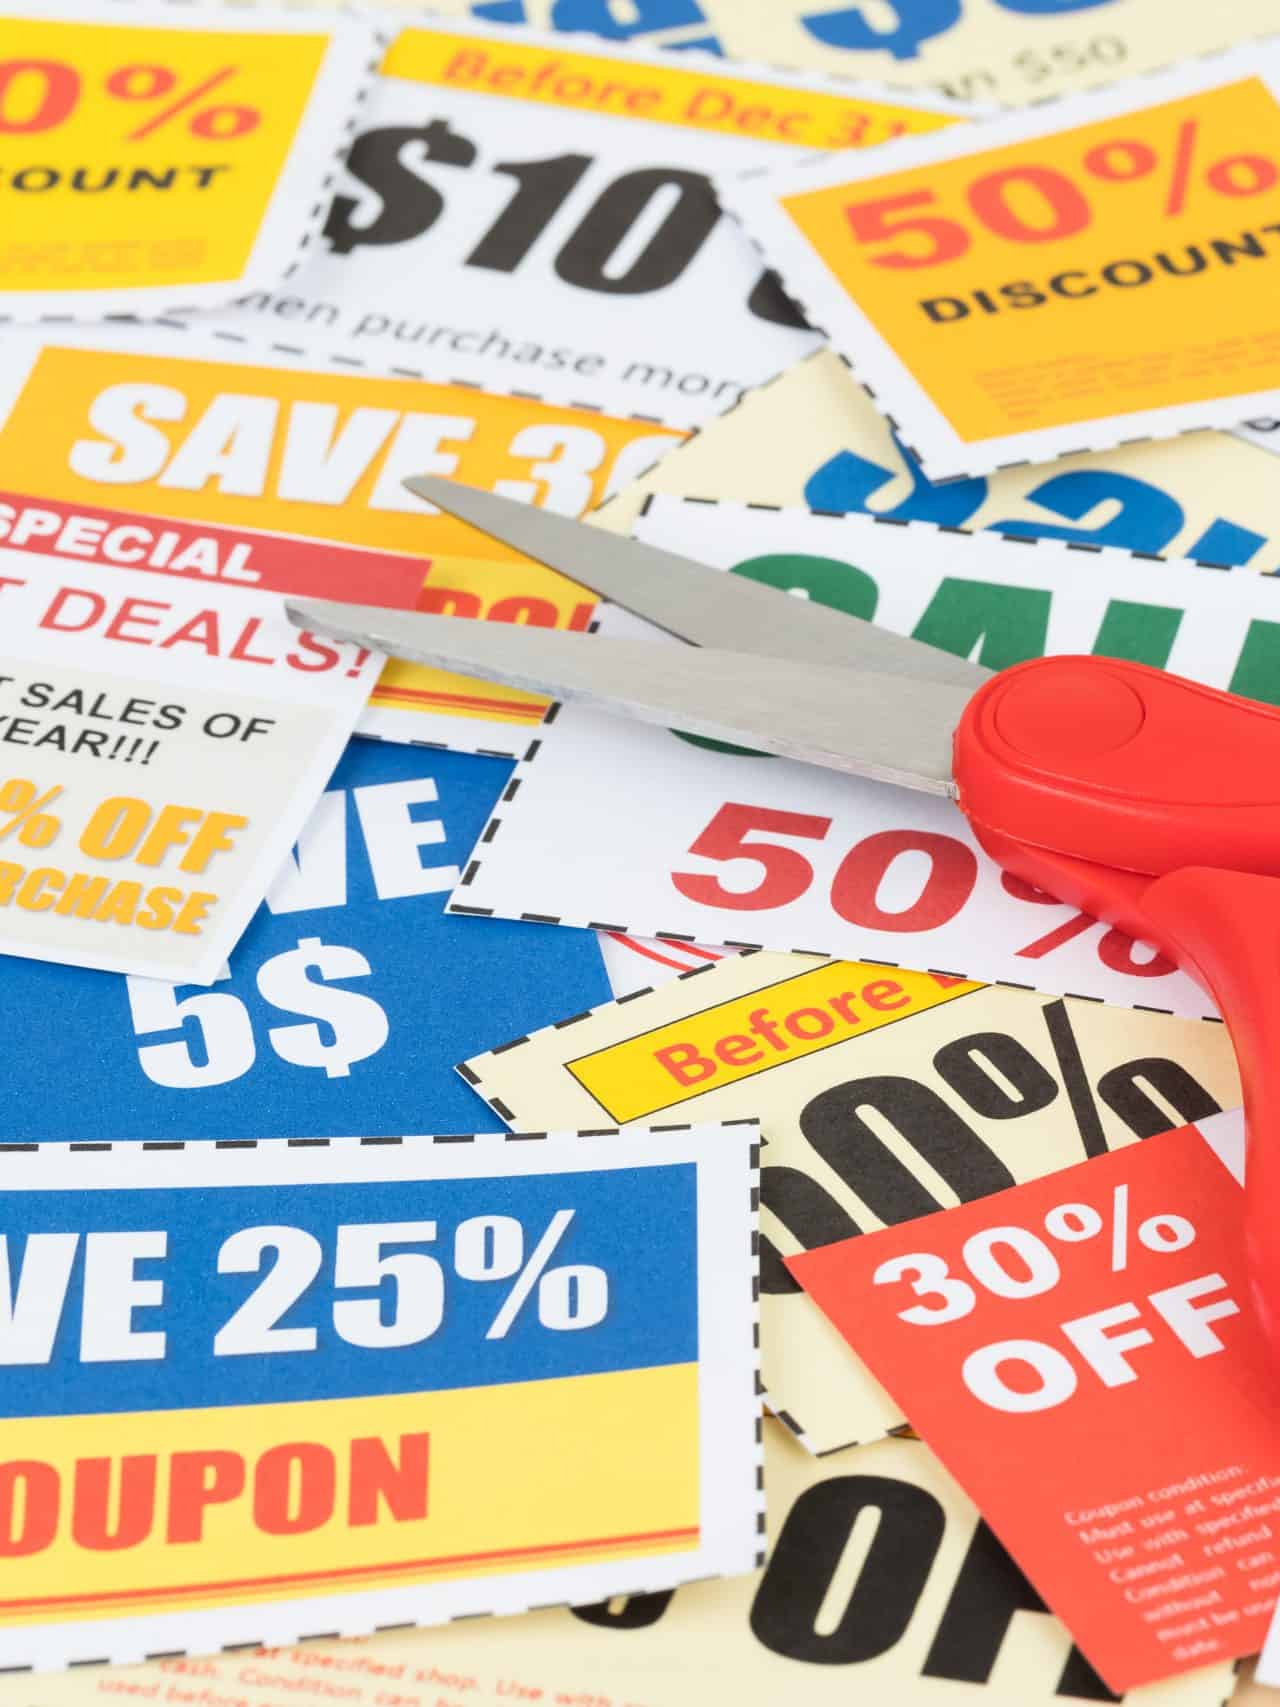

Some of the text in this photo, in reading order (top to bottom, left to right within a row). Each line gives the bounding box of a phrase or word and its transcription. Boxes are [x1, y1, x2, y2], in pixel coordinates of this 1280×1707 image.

[441, 46, 662, 114] Before
[683, 87, 812, 140] Dec
[0, 164, 232, 192] OUNT
[320, 119, 722, 296] $10
[843, 117, 1280, 271] 50%
[351, 310, 606, 376] purchase
[68, 383, 475, 515] SAVE
[0, 715, 160, 766] EAR!!!
[20, 682, 276, 744] SALES OF
[79, 796, 249, 876] OFF
[671, 802, 1179, 977] 50%
[126, 937, 389, 1089] 5$
[653, 977, 912, 1088] Before
[212, 1208, 610, 1357] 25%
[873, 1184, 1196, 1325] 30%
[962, 1272, 1241, 1413] OFF
[1064, 1494, 1145, 1526] Coupon
